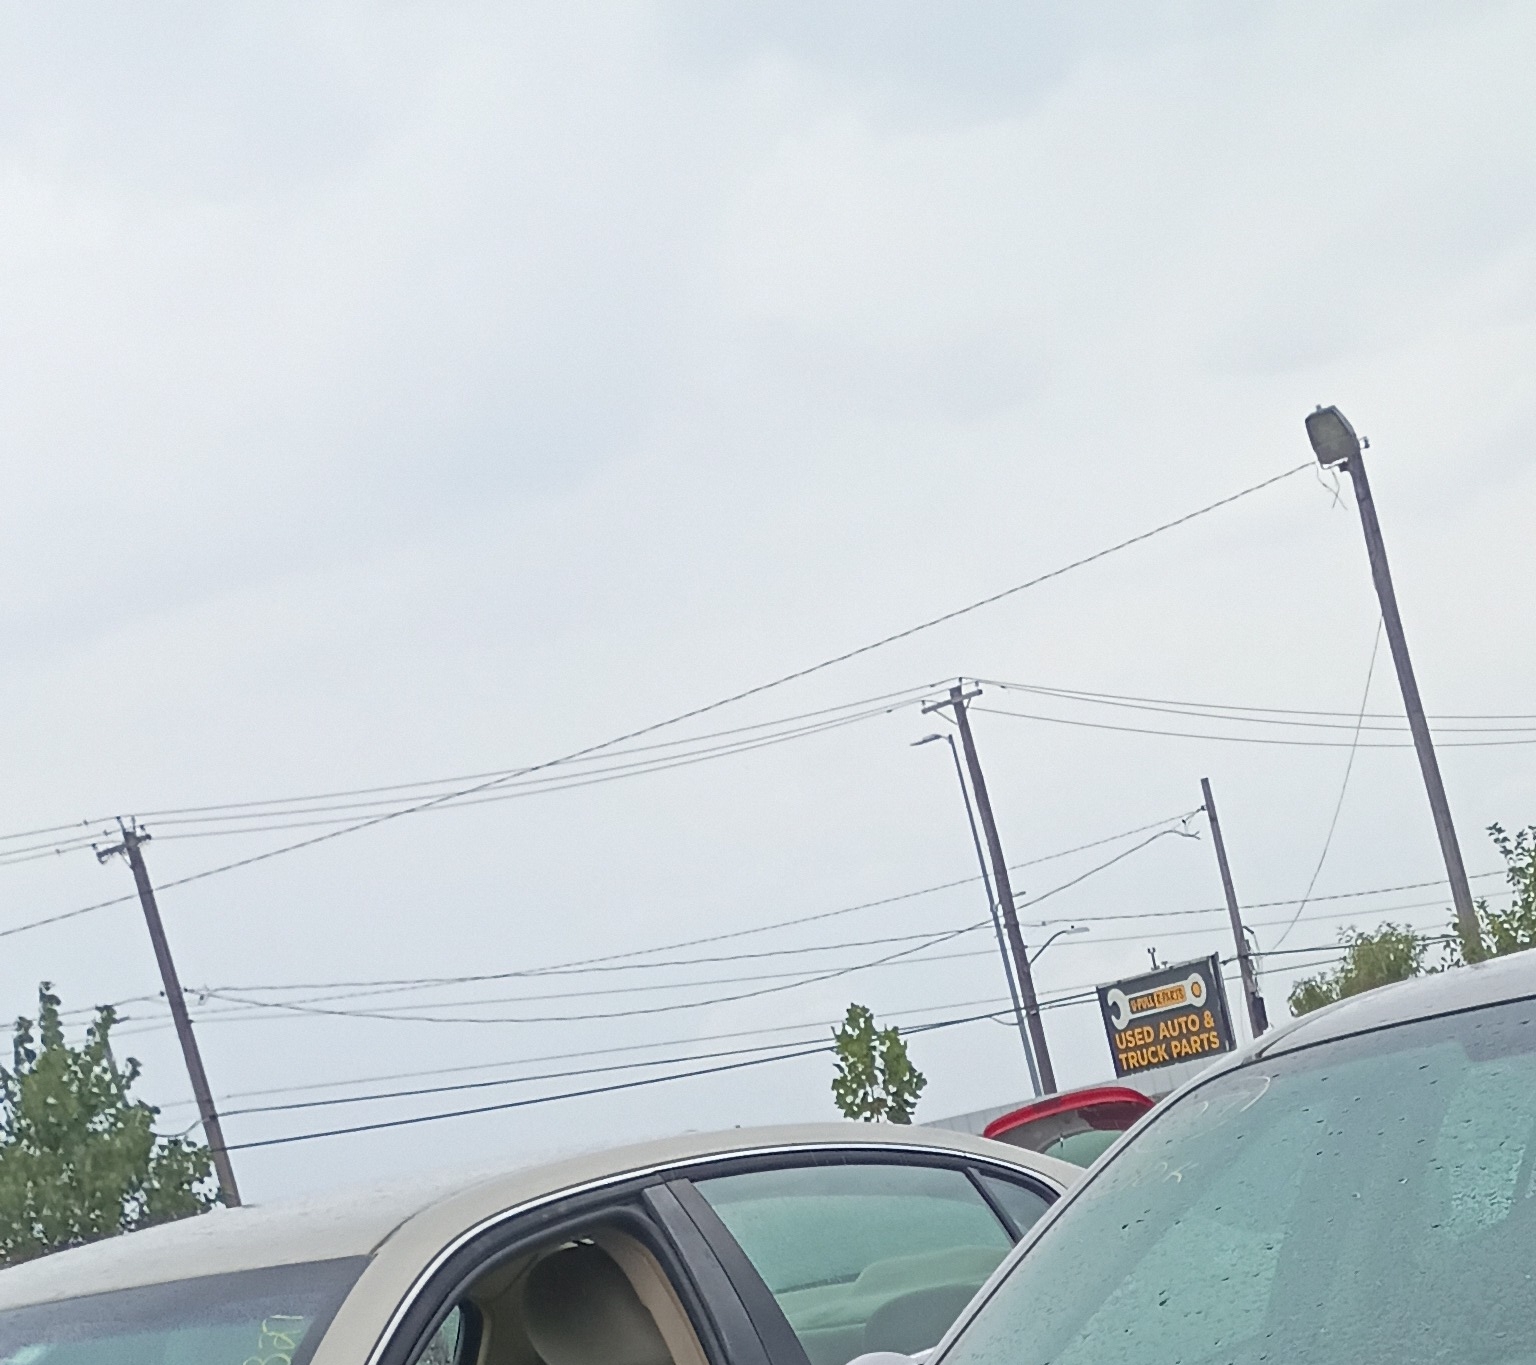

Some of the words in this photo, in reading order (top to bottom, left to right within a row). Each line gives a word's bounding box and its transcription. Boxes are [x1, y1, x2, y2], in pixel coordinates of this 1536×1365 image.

[1115, 1026, 1154, 1050] USED
[1159, 1014, 1200, 1040] AUTO
[1203, 1010, 1215, 1029] &
[1118, 1044, 1169, 1070] TRUCK
[1171, 1031, 1219, 1056] PARTS
